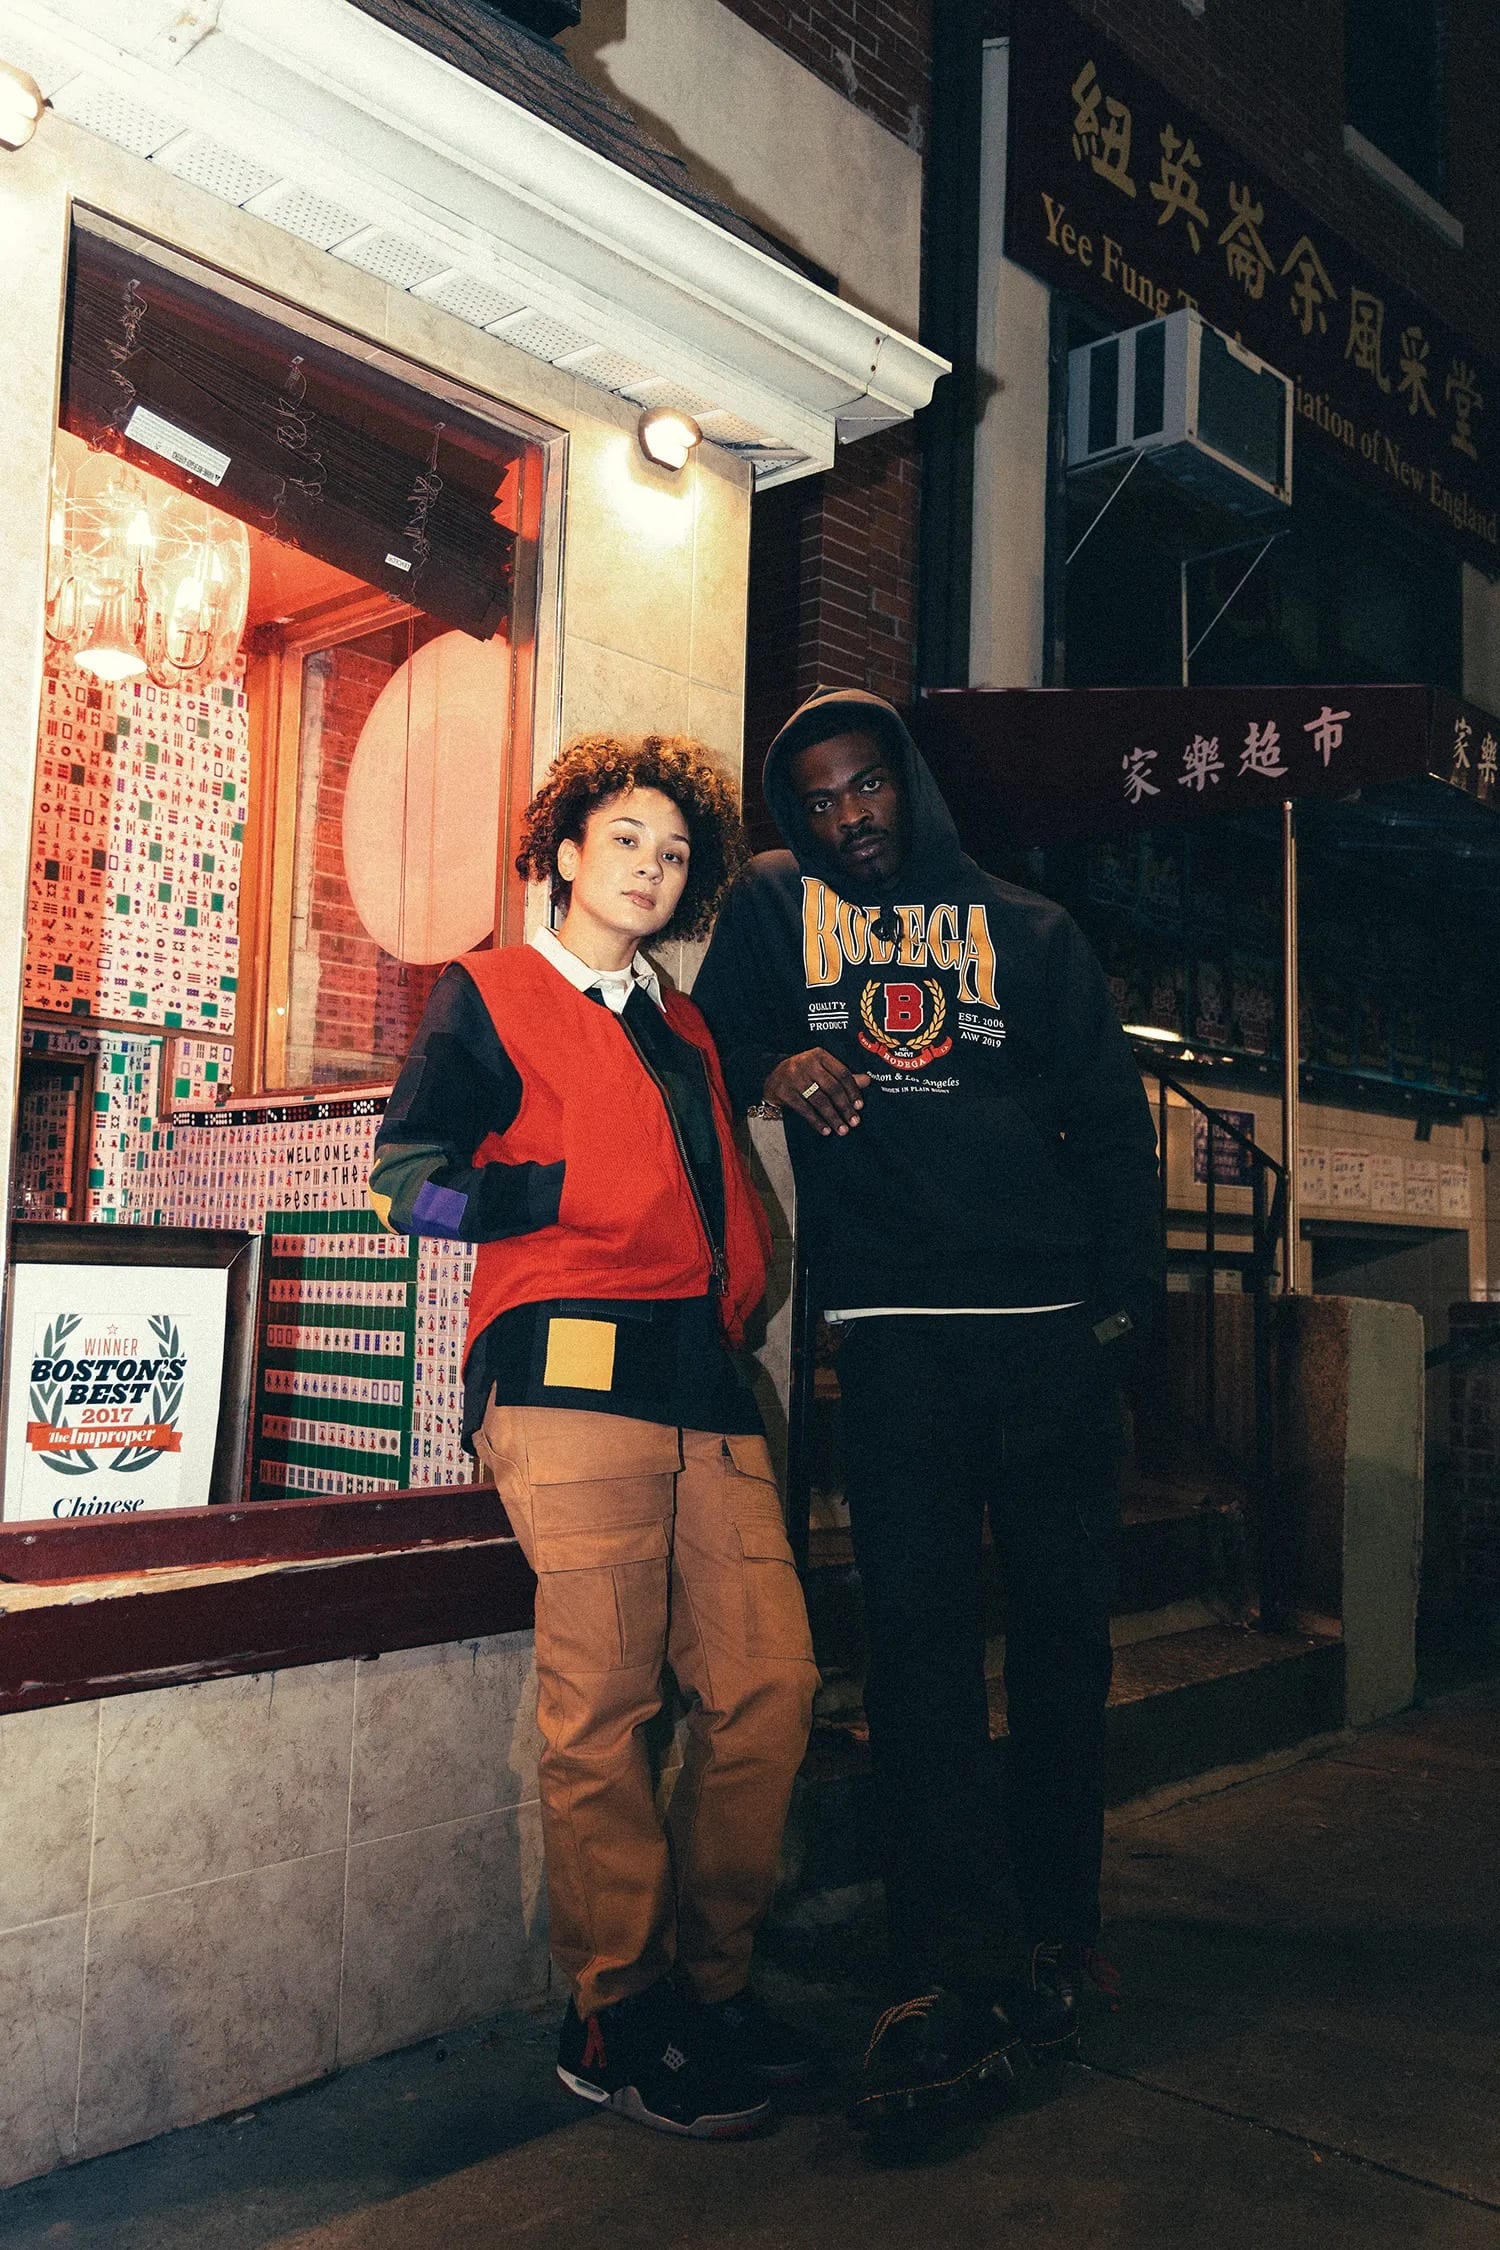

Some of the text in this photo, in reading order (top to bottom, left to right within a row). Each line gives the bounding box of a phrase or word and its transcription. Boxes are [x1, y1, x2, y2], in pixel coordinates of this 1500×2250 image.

[1041, 191, 1094, 268] Yee
[1101, 233, 1171, 318] Fung
[1360, 430, 1385, 461] of
[1384, 438, 1425, 490] New
[1428, 470, 1498, 545] England
[1121, 705, 1352, 806] 家樂超市
[808, 1001, 847, 1013] QUALITY
[884, 982, 924, 1032] B
[809, 1021, 849, 1031] PRODUCT
[958, 1012, 1005, 1029] EST. 2006
[982, 1036, 1002, 1048] 2019
[883, 1053, 927, 1069] BODEGA
[894, 1073, 904, 1081] &
[922, 1077, 961, 1089] Angeles
[286, 1143, 352, 1165] WELCOME
[295, 1170, 312, 1186] TO
[84, 1338, 138, 1357] WINNER
[65, 1384, 151, 1406] BEST
[81, 1407, 134, 1425] 2017
[69, 1428, 156, 1448] Improper
[52, 1495, 145, 1521] Chinese
